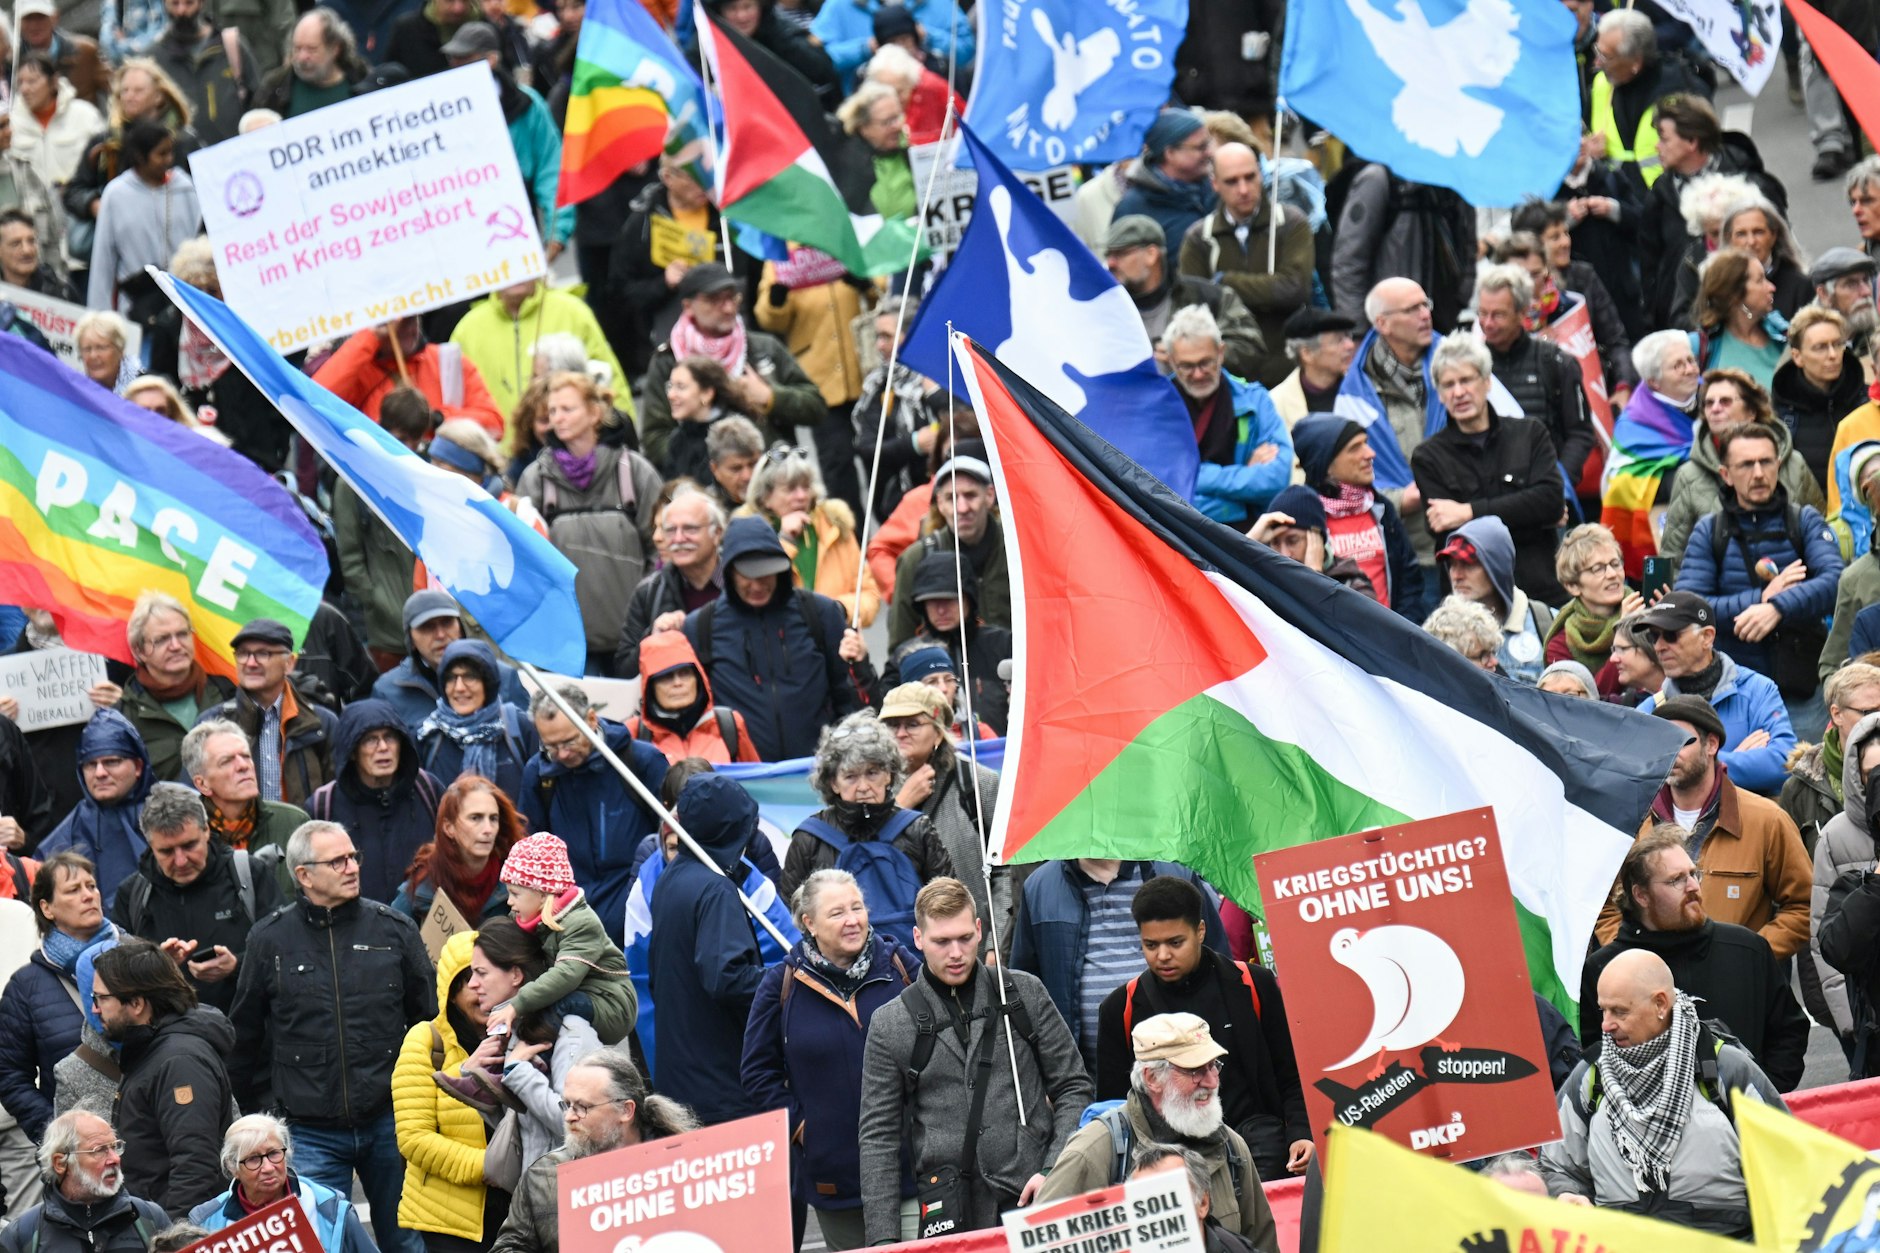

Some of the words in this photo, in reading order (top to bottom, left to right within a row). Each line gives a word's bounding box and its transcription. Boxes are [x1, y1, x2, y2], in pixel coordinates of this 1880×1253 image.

[269, 136, 322, 171] DDR
[332, 128, 363, 153] im
[369, 95, 473, 138] Frieden
[308, 132, 446, 191] annektiert
[224, 230, 279, 267] Rest
[284, 215, 323, 246] der
[329, 161, 500, 229] Sowjetunion
[257, 262, 288, 287] im
[293, 235, 362, 273] Krieg
[370, 198, 477, 249] zerstört
[267, 311, 354, 348] rbeiter
[364, 277, 454, 319] wacht
[466, 259, 511, 290] auf
[35, 449, 257, 612] PACE
[5, 670, 28, 689] DIE
[29, 653, 100, 683] WAFFEN
[1272, 836, 1488, 900] KRIEGSTÜCHTIG?
[1298, 882, 1390, 923] OHNE
[1395, 864, 1474, 903] UNS!
[1338, 1069, 1416, 1127] US-Raketen
[1437, 1057, 1506, 1079] stoppen!
[1409, 1121, 1466, 1151] DKP
[570, 1140, 776, 1210] KRIEGSTÜCHTIG?
[589, 1188, 676, 1232] OHNE
[683, 1169, 756, 1210] UNS!
[1020, 1222, 1061, 1249] DER
[1066, 1205, 1128, 1237] KRIEG
[1132, 1191, 1182, 1219] SOLL
[1136, 1213, 1187, 1243] SEIN!
